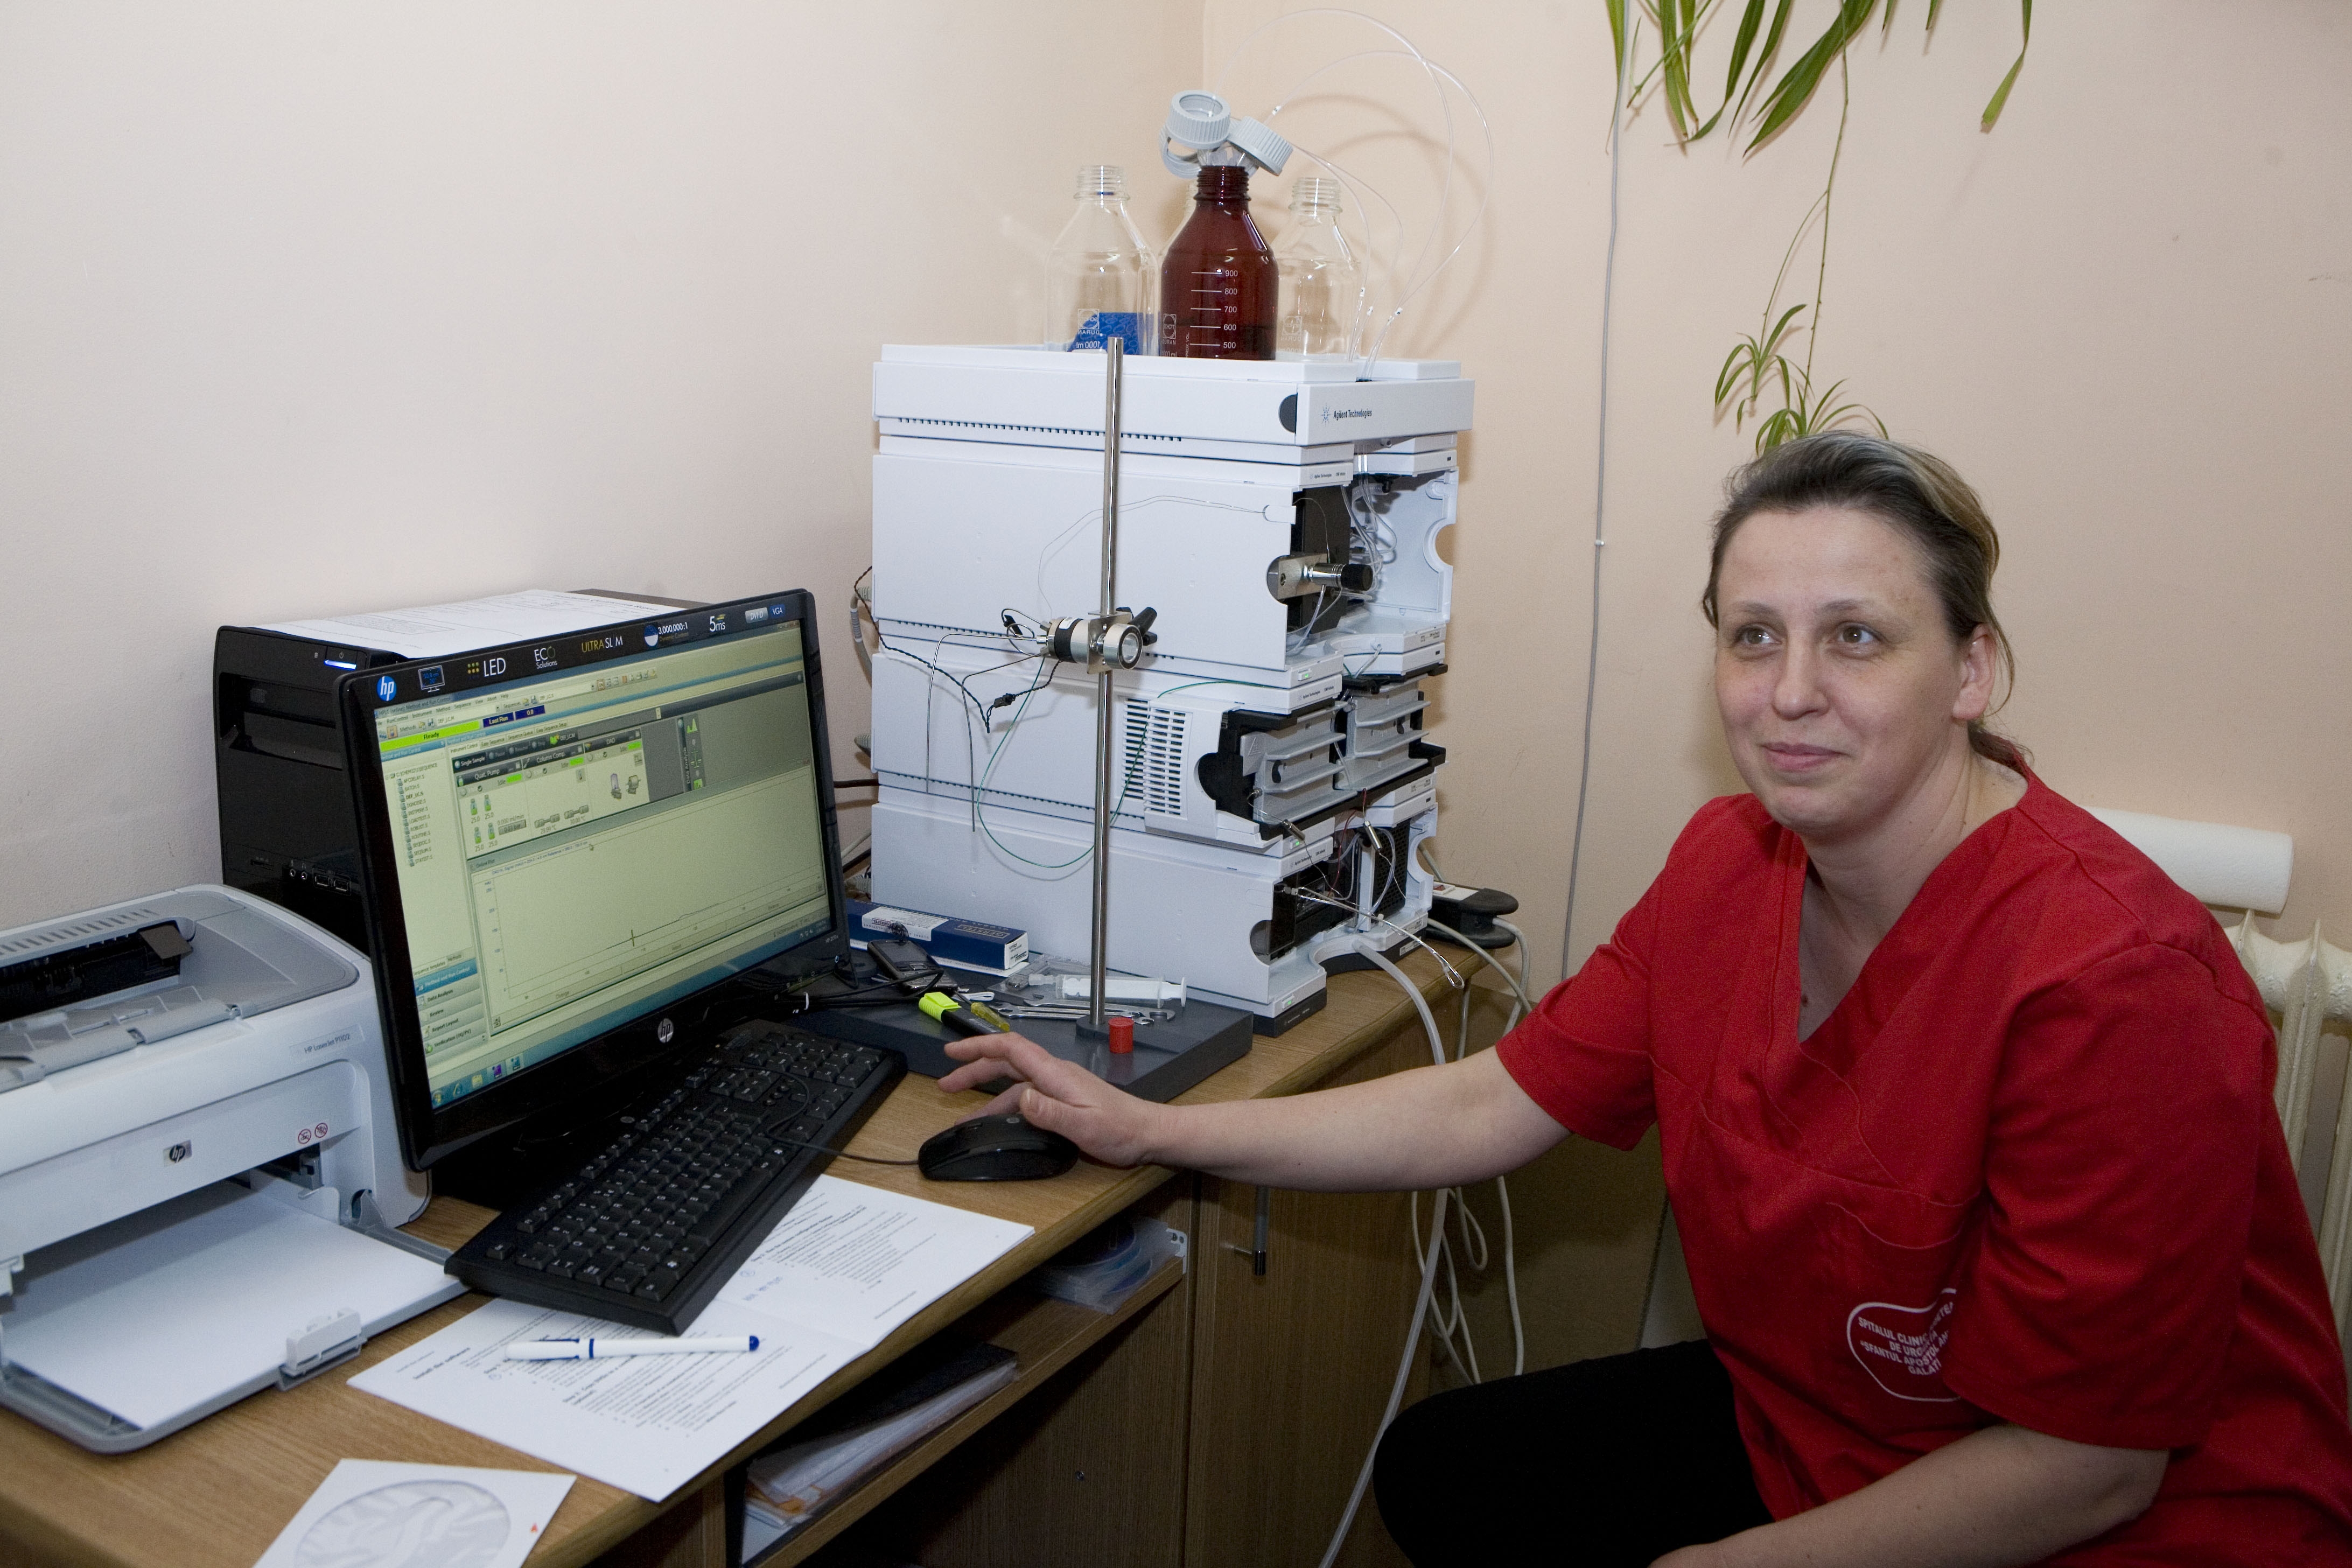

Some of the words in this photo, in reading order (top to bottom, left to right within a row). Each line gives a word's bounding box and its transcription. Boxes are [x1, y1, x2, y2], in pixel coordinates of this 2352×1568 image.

[1333, 410, 1347, 421] Agilent
[1348, 408, 1372, 418] Technologies
[658, 621, 688, 634] 3,000,000:1
[709, 615, 726, 632] 5ms
[484, 657, 506, 677] LED
[536, 660, 558, 669] Solutions
[380, 676, 395, 702] hp
[454, 701, 472, 710] Sequence
[423, 732, 439, 740] Ready
[489, 737, 506, 746] Sequence
[472, 756, 486, 765] Sample
[536, 754, 552, 764] Column
[552, 751, 565, 759] Comp.
[487, 768, 500, 776] Pump
[471, 816, 480, 824] 25.0
[484, 812, 494, 820] 25.0
[474, 844, 484, 852] 25.0
[488, 840, 498, 848] 25.0
[962, 925, 1004, 937] GERSTEL
[437, 989, 454, 999] Analysis
[430, 1009, 444, 1017] Review
[432, 1024, 445, 1033] Report
[445, 1018, 459, 1028] Layout
[660, 1019, 671, 1042] hp
[304, 1045, 312, 1054] HP
[313, 1039, 334, 1051] LaserJet
[335, 1033, 350, 1043] P1102
[433, 1035, 456, 1048] Verification
[172, 1145, 184, 1164] hp
[1858, 1317, 1897, 1341] SPITALUL
[1889, 1340, 1902, 1353] DE
